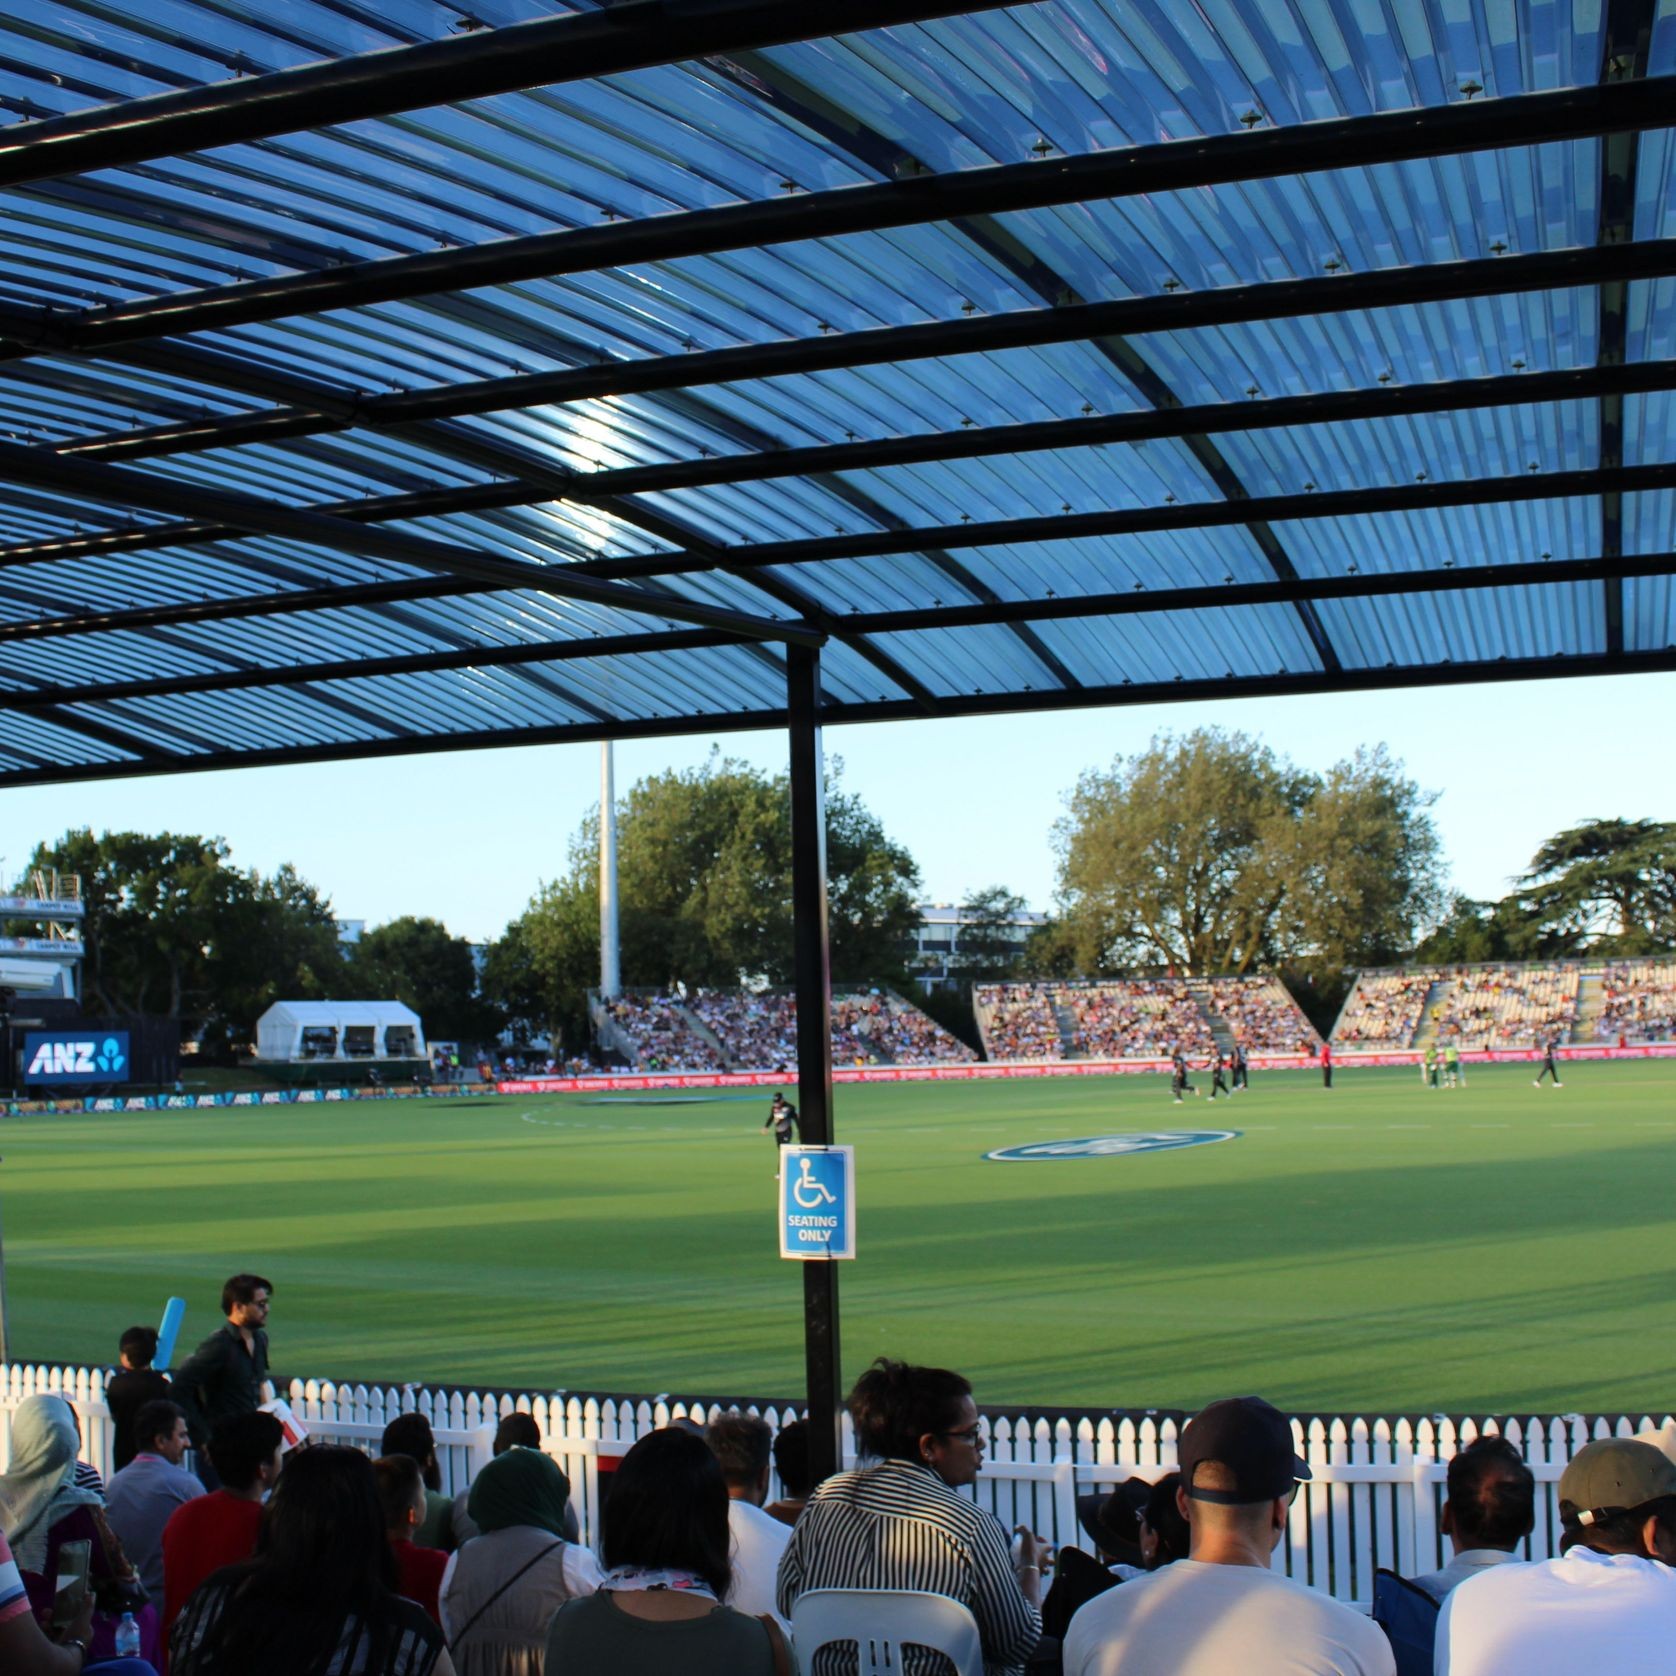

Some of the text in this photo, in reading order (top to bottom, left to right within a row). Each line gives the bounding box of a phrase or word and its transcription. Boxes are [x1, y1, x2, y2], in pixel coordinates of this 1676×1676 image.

[28, 1042, 96, 1074] ANZ
[788, 1215, 838, 1227] SEATING
[798, 1229, 832, 1242] ONLY
